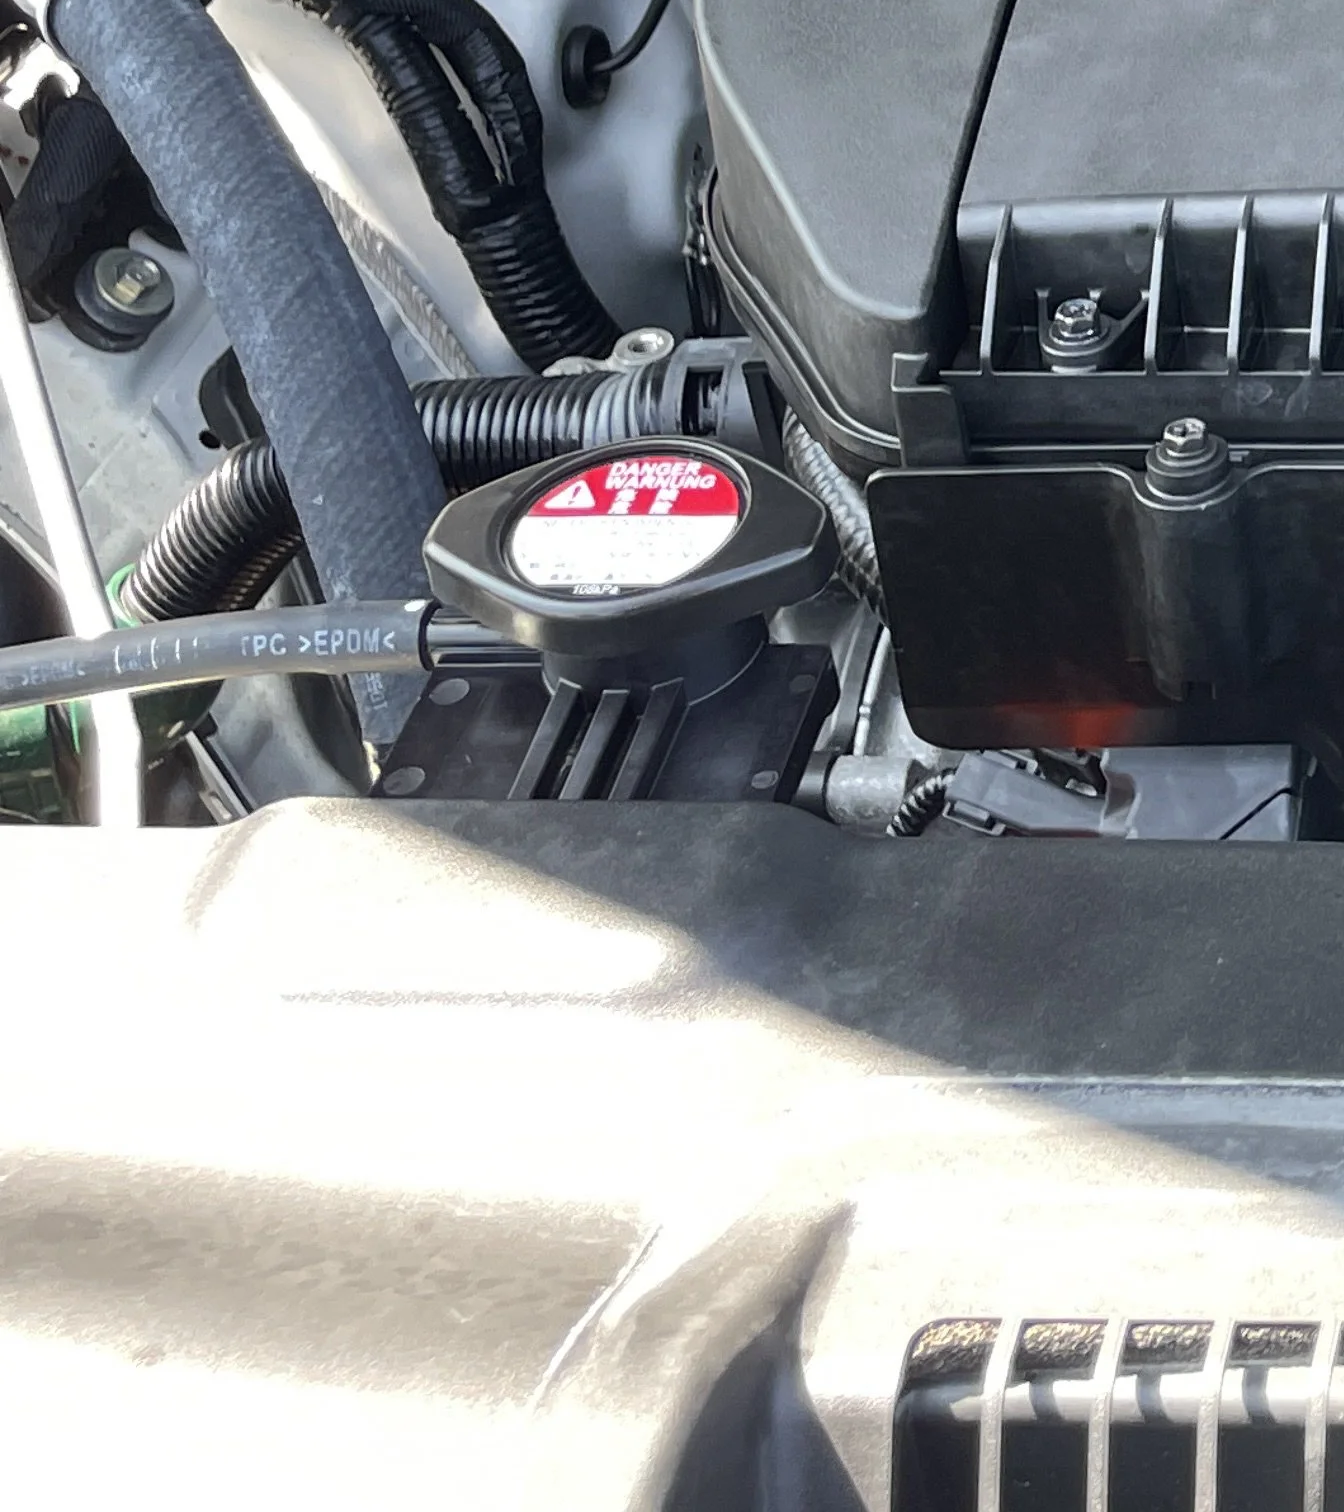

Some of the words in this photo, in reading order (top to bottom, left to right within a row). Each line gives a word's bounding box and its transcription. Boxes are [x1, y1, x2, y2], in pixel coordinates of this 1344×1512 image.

[609, 461, 703, 476] DANGER
[605, 474, 717, 490] WARNUNG
[299, 628, 396, 656] >EPDM<
